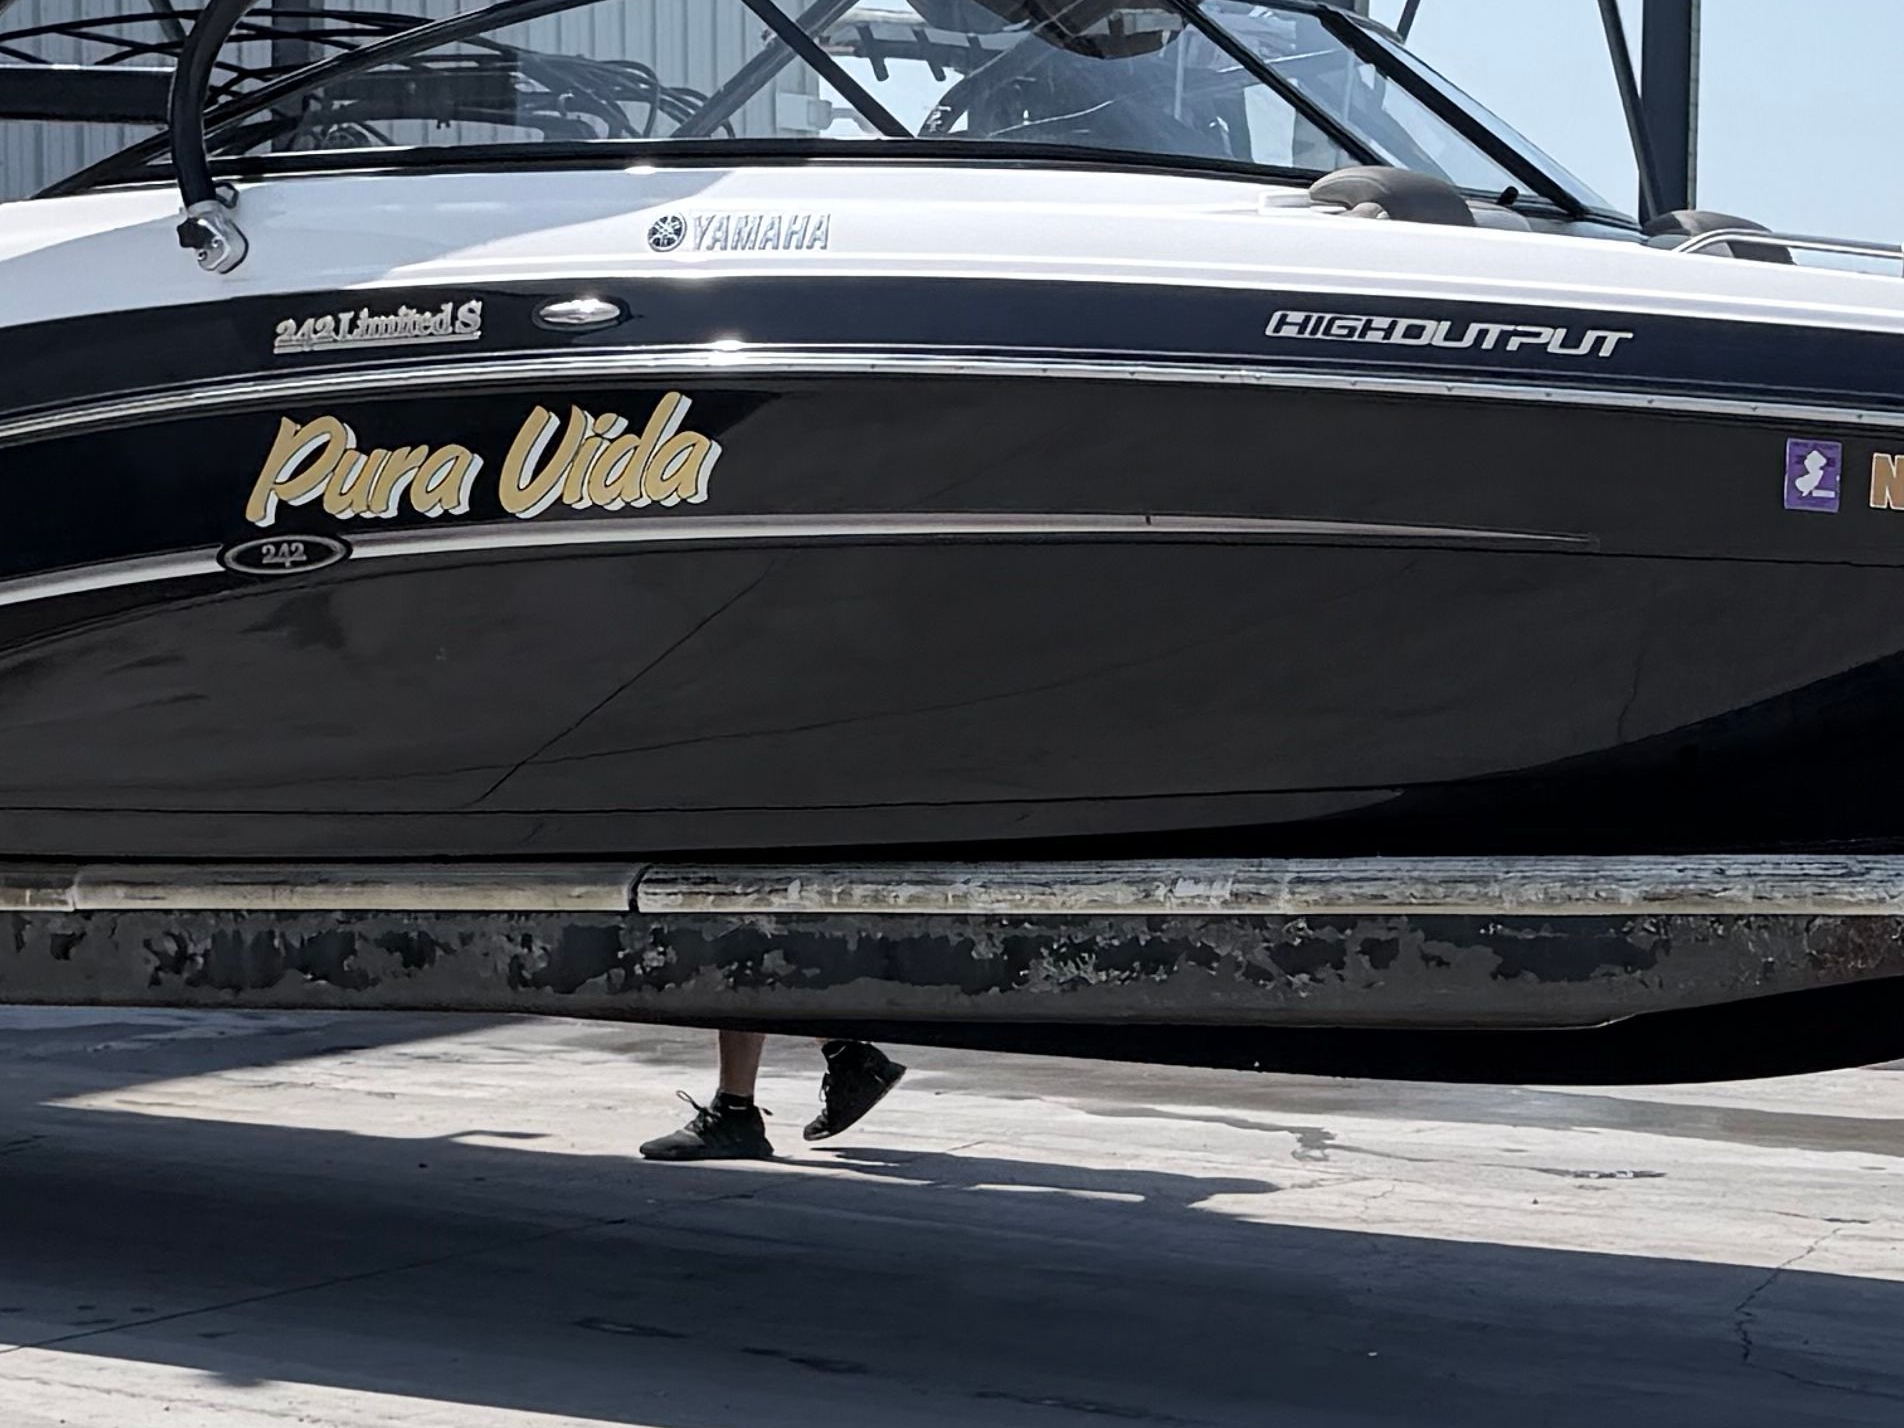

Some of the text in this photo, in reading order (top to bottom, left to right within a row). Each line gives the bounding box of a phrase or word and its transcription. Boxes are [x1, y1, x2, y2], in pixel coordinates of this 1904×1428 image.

[693, 213, 832, 251] YAMAHA
[274, 299, 483, 353] 242 Limited S
[245, 391, 723, 528] Pura Vida
[261, 542, 307, 568] 242
